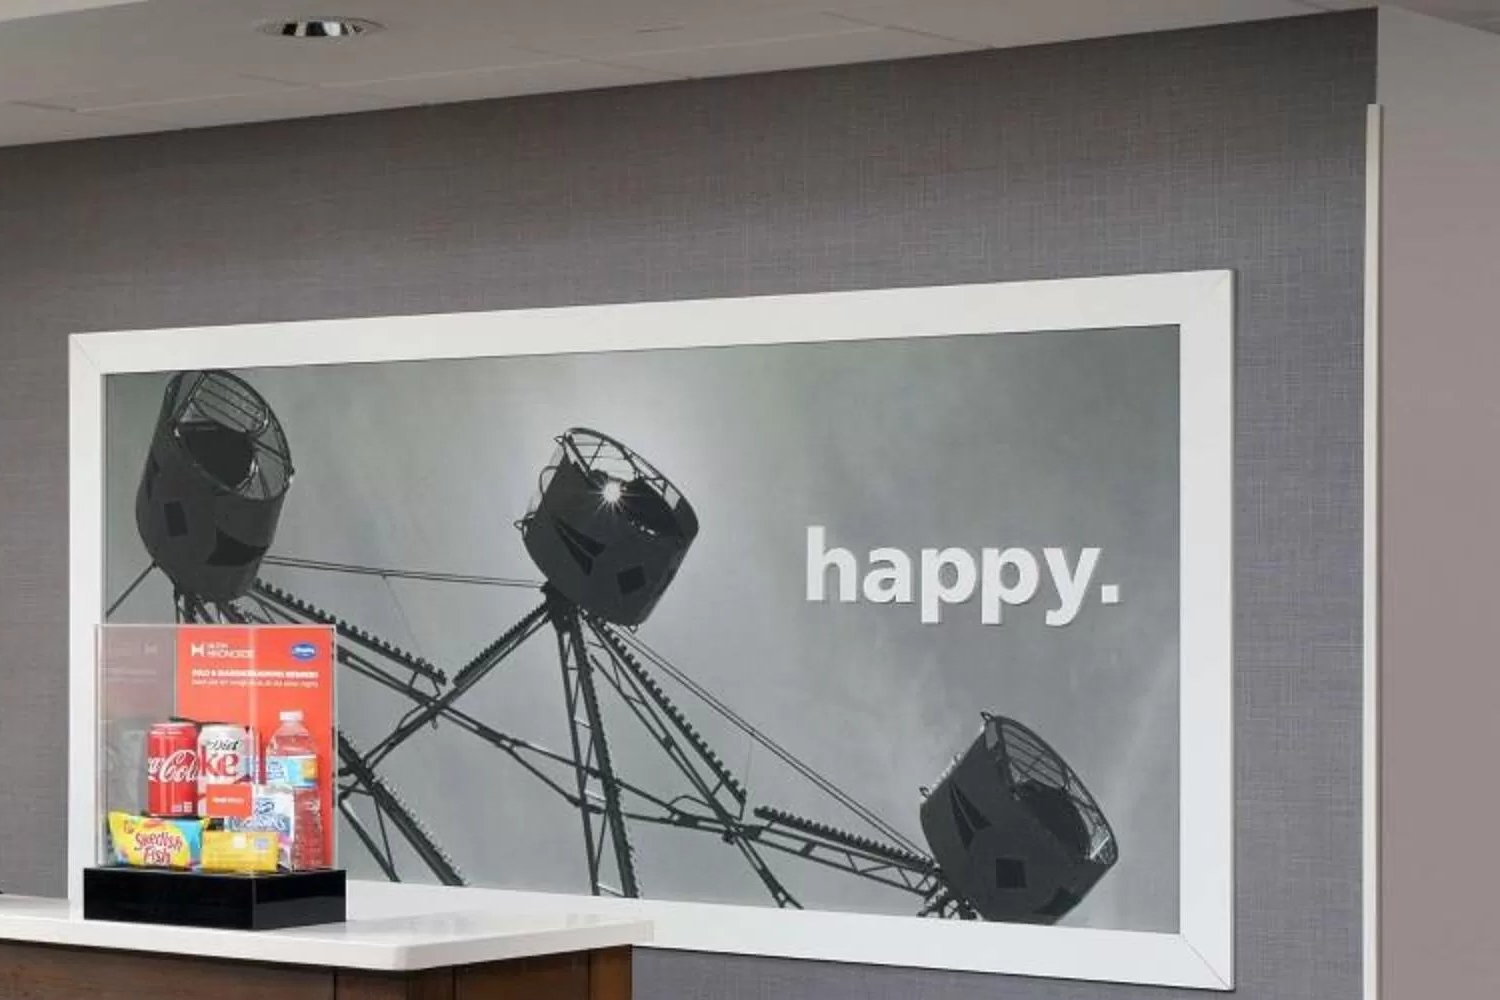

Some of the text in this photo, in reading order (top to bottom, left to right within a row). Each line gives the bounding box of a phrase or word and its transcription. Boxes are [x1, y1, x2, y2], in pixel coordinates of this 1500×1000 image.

[806, 525, 1119, 626] happy.
[200, 745, 239, 777] ke
[135, 831, 184, 852] Swedish
[143, 847, 171, 863] Fish
